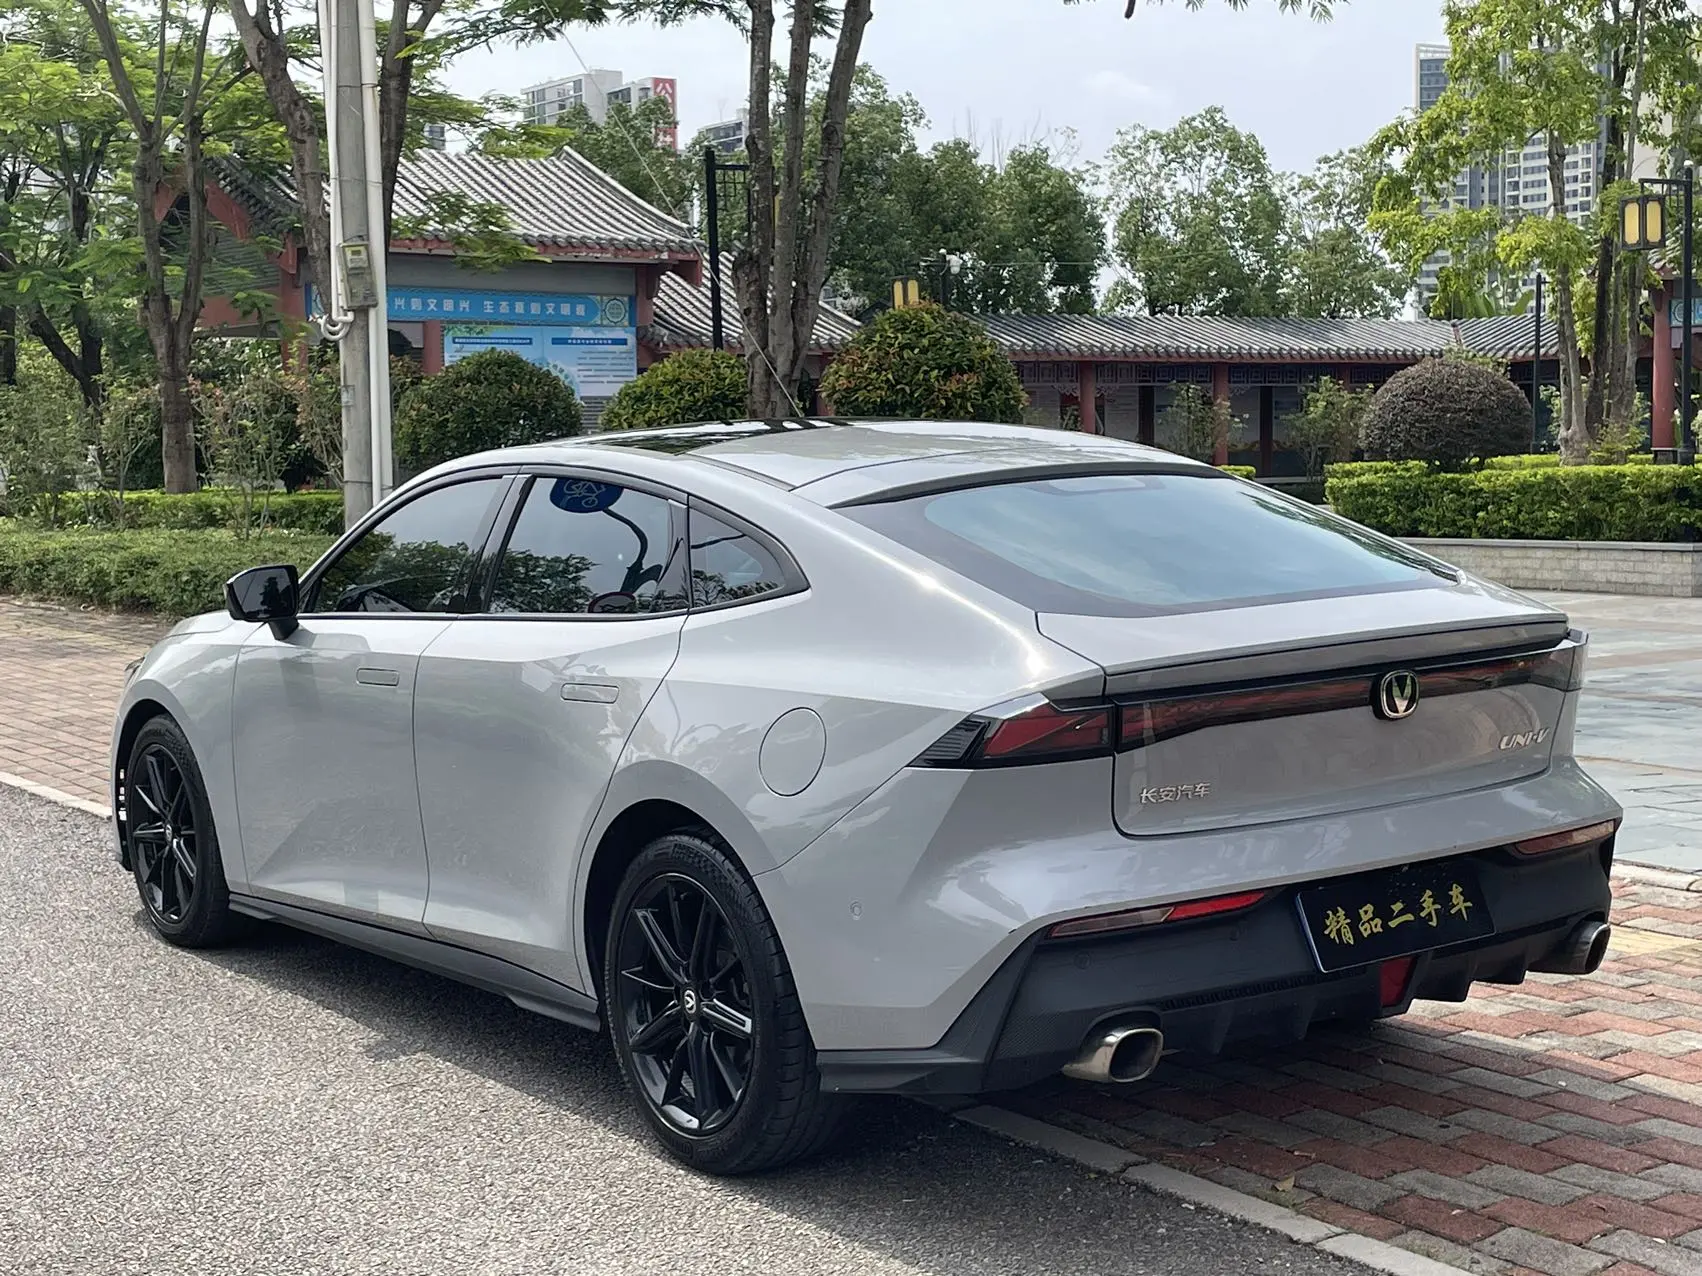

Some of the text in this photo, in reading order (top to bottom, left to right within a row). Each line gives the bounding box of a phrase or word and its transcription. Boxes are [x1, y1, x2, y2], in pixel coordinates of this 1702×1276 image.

[1500, 728, 1550, 750] UNI-V
[1140, 782, 1211, 804] 长安汽车
[1323, 883, 1473, 945] 精品二手车
